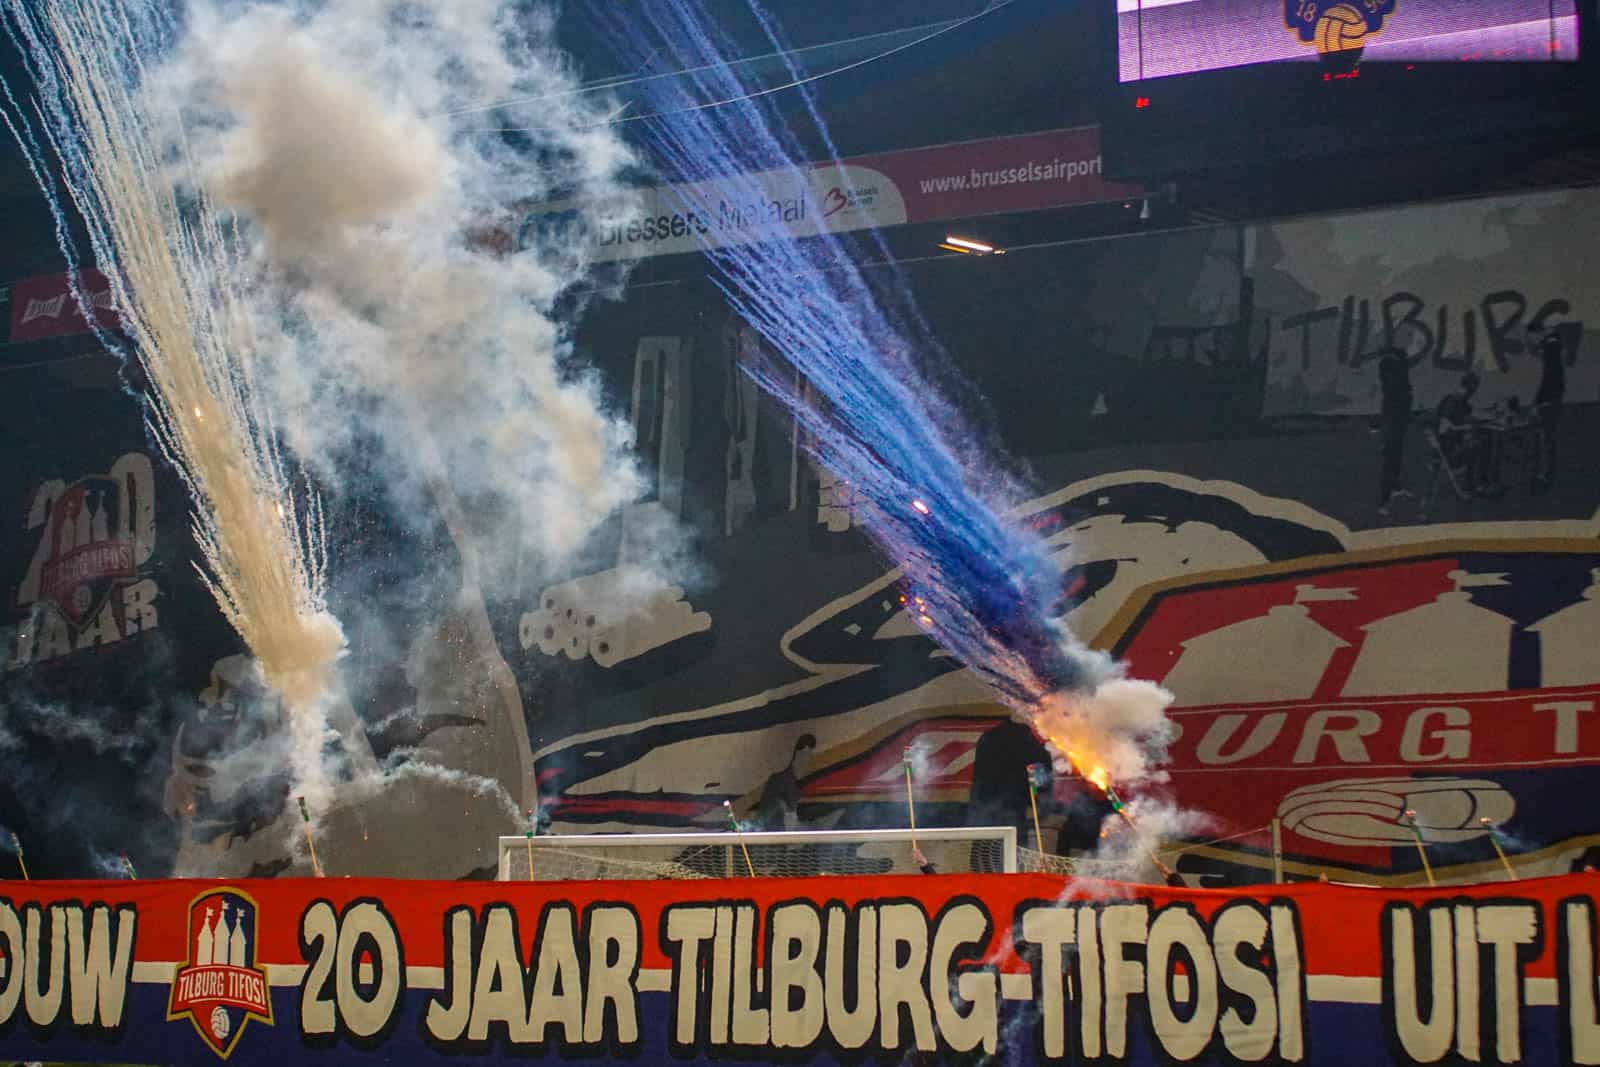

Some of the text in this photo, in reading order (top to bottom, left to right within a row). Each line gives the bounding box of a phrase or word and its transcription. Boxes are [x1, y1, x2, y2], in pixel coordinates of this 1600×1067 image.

[1282, 289, 1570, 374] TILBURG
[1168, 706, 1472, 764] URG
[178, 971, 267, 1006] TILBURG TIFOSI
[301, 901, 400, 1039] 20
[426, 904, 641, 1043] JAAR
[666, 902, 999, 1056] TILBURG
[1021, 903, 1305, 1064] TIFOSI
[1391, 904, 1538, 1063] UIT
